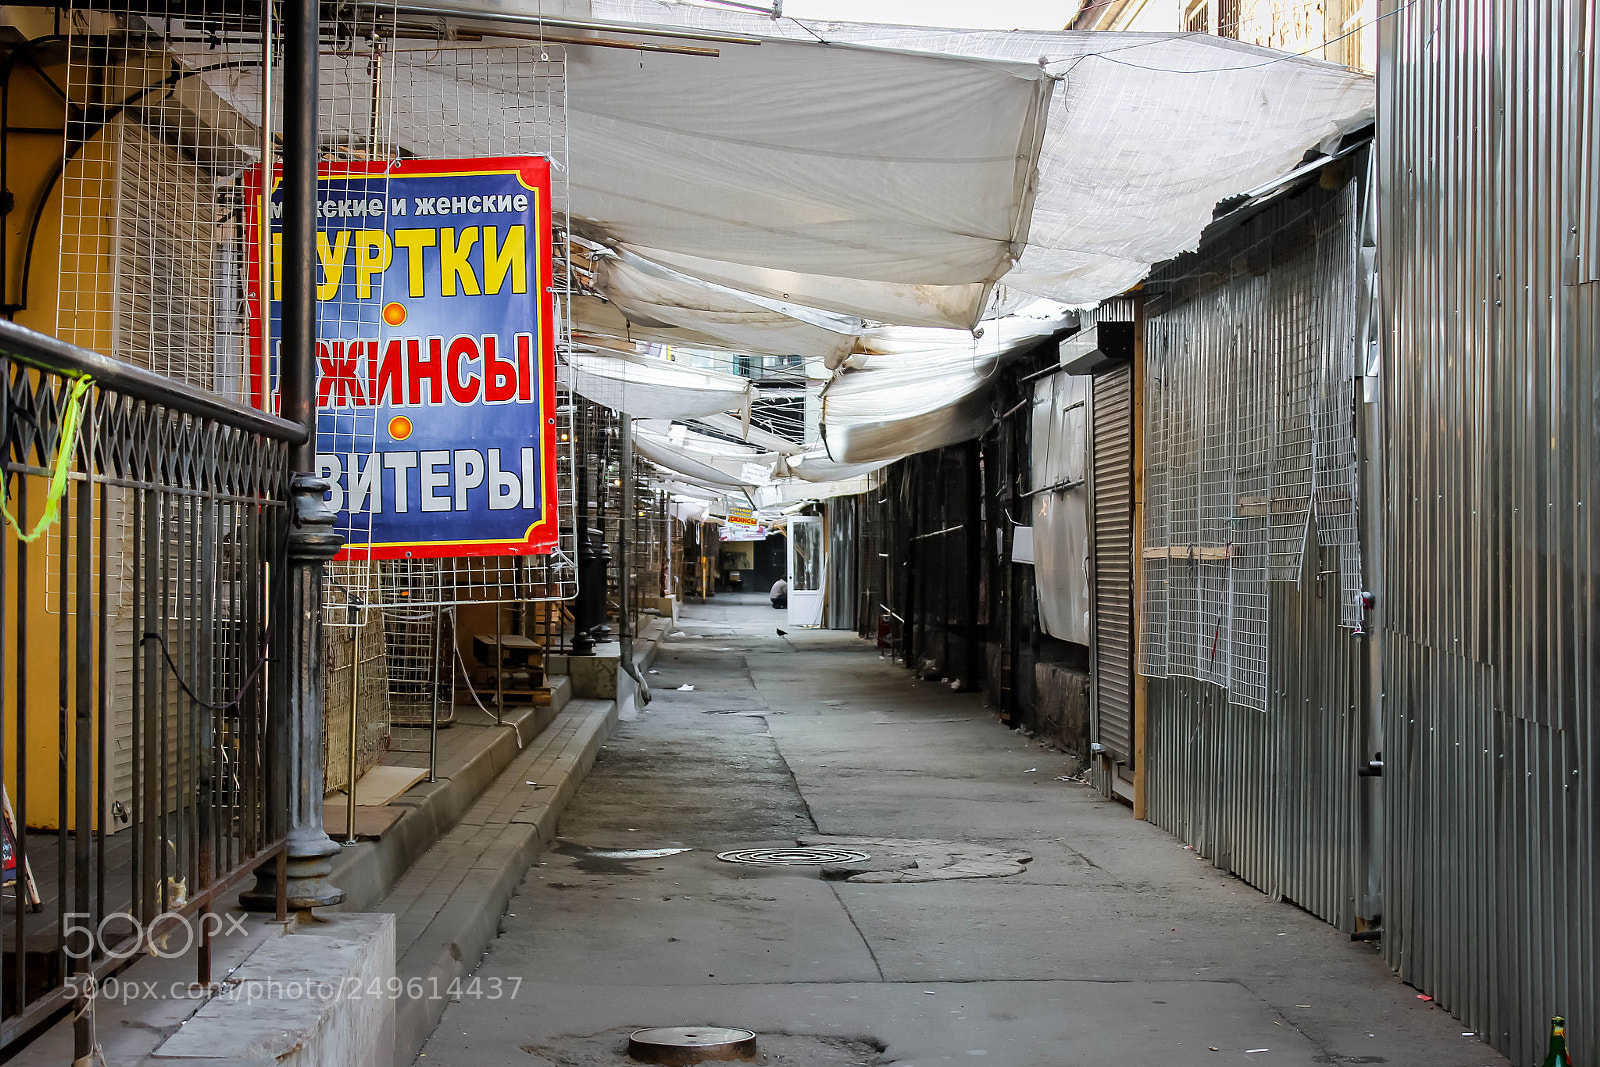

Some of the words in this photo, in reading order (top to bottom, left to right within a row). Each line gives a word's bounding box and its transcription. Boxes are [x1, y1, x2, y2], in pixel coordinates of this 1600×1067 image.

[270, 198, 384, 219] мские
[391, 198, 407, 216] и
[414, 194, 528, 216] женские
[272, 225, 527, 301] УРТКИ
[272, 332, 534, 415] ЖИНСЫ
[315, 447, 535, 514] ВИТЕРЫ
